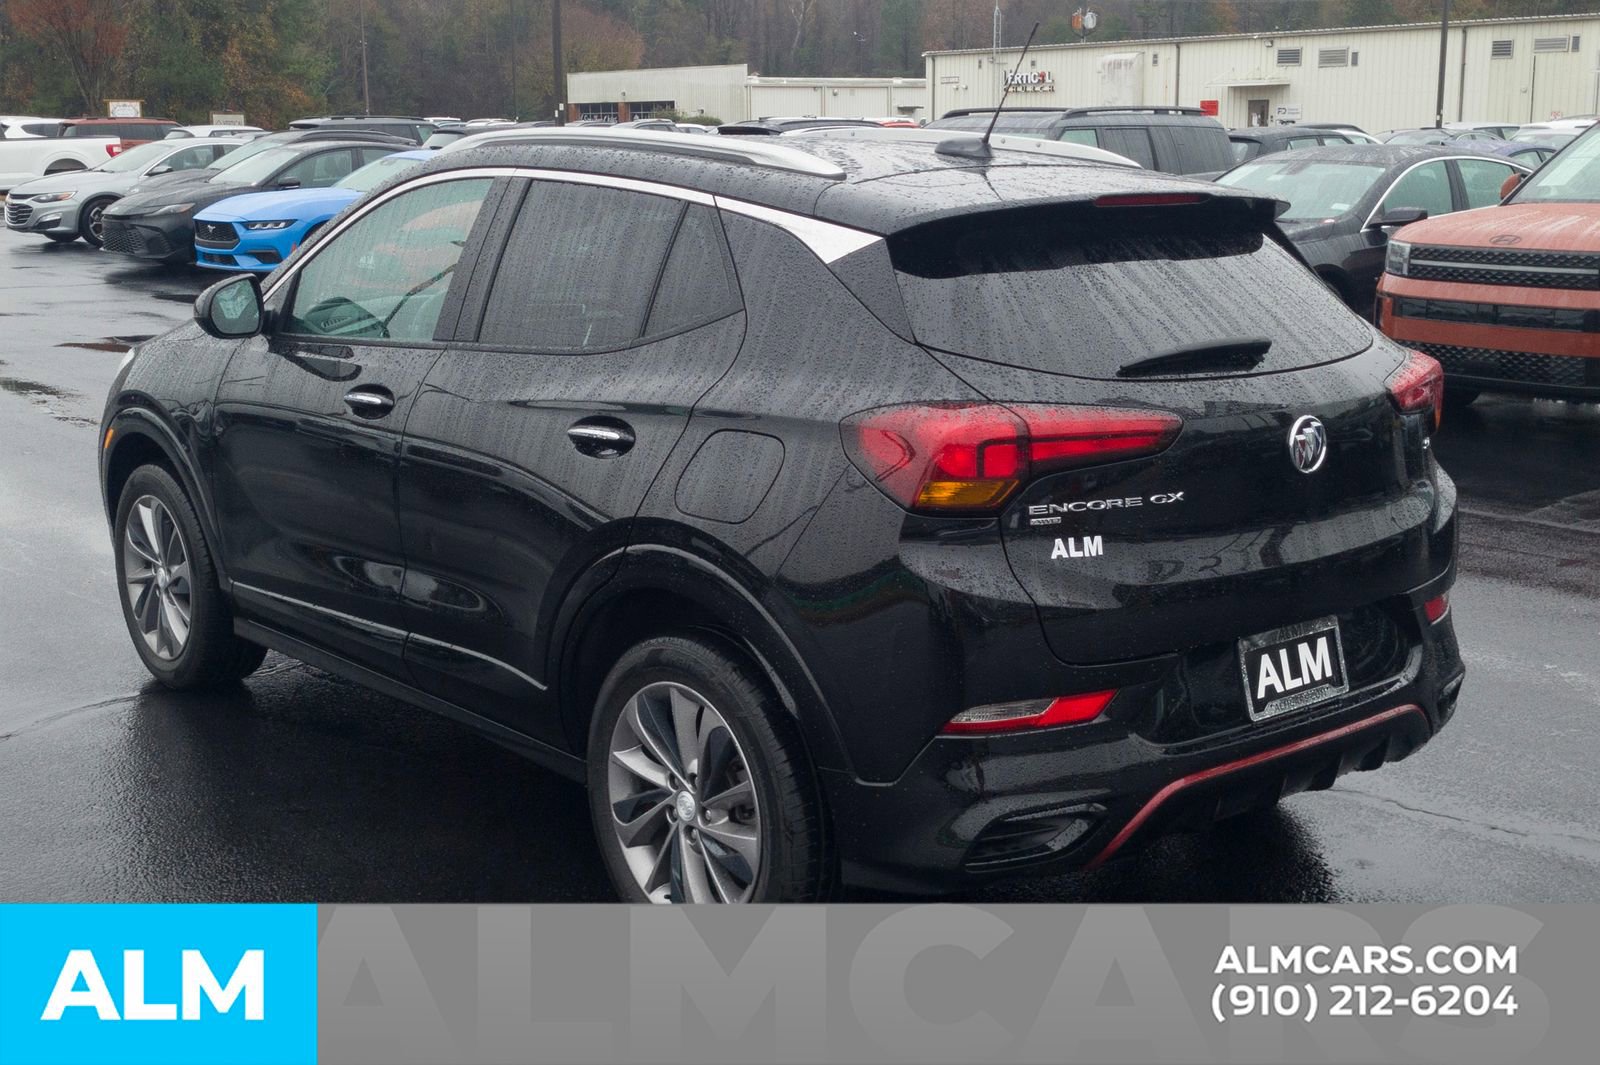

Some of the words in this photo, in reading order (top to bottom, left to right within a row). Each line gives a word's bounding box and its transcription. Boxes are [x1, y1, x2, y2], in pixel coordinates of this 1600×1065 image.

[1028, 496, 1143, 515] ENCORE
[1150, 491, 1185, 504] GX
[1051, 535, 1104, 559] ALM
[1257, 636, 1333, 699] ALM
